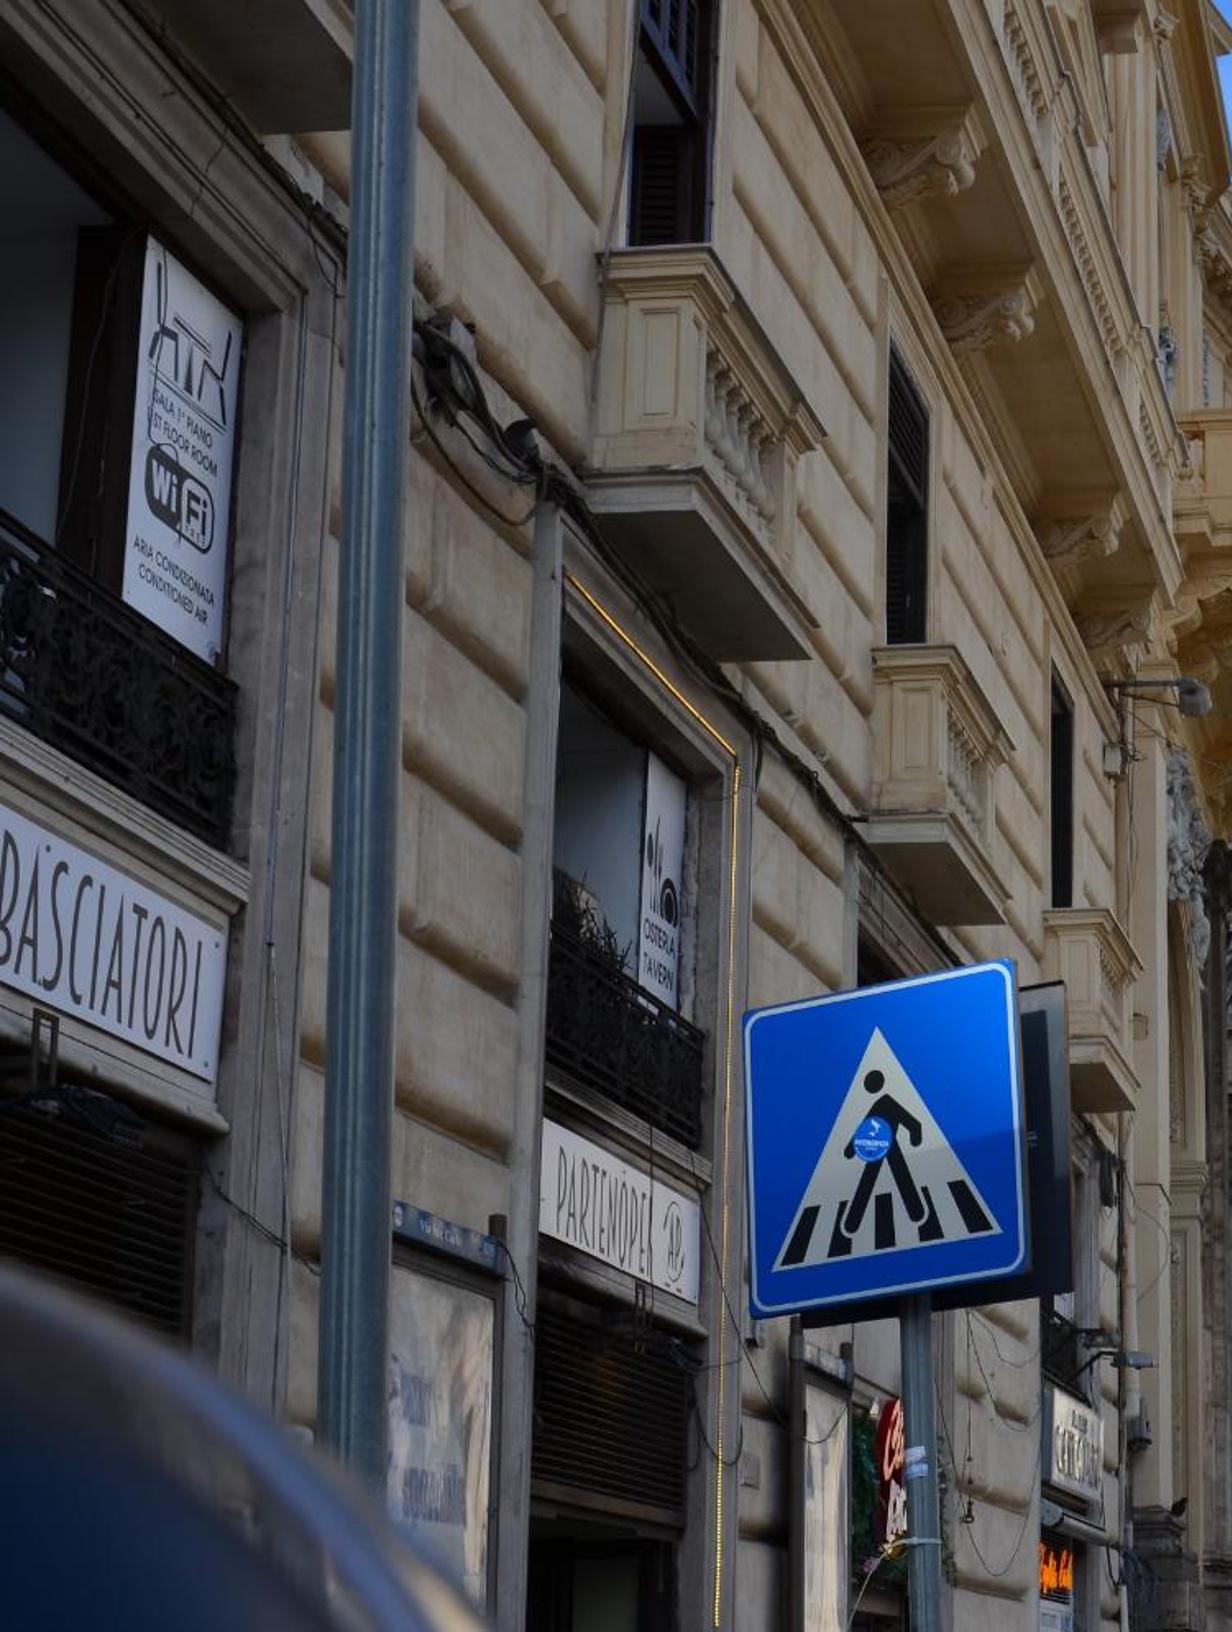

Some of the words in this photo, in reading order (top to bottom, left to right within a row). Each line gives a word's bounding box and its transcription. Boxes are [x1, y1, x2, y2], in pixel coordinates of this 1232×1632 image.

[164, 420, 190, 454] FLOOR
[191, 445, 218, 478] ROOM
[187, 416, 213, 449] PIANO
[133, 534, 154, 562] ARIA
[156, 551, 215, 606] CONDIZIONATA
[138, 563, 193, 614] CONDITIONED
[194, 605, 208, 625] AIR
[0, 829, 203, 1060] BASCIATORI
[643, 917, 676, 960] OSTERIA
[643, 951, 674, 993] TAVERN
